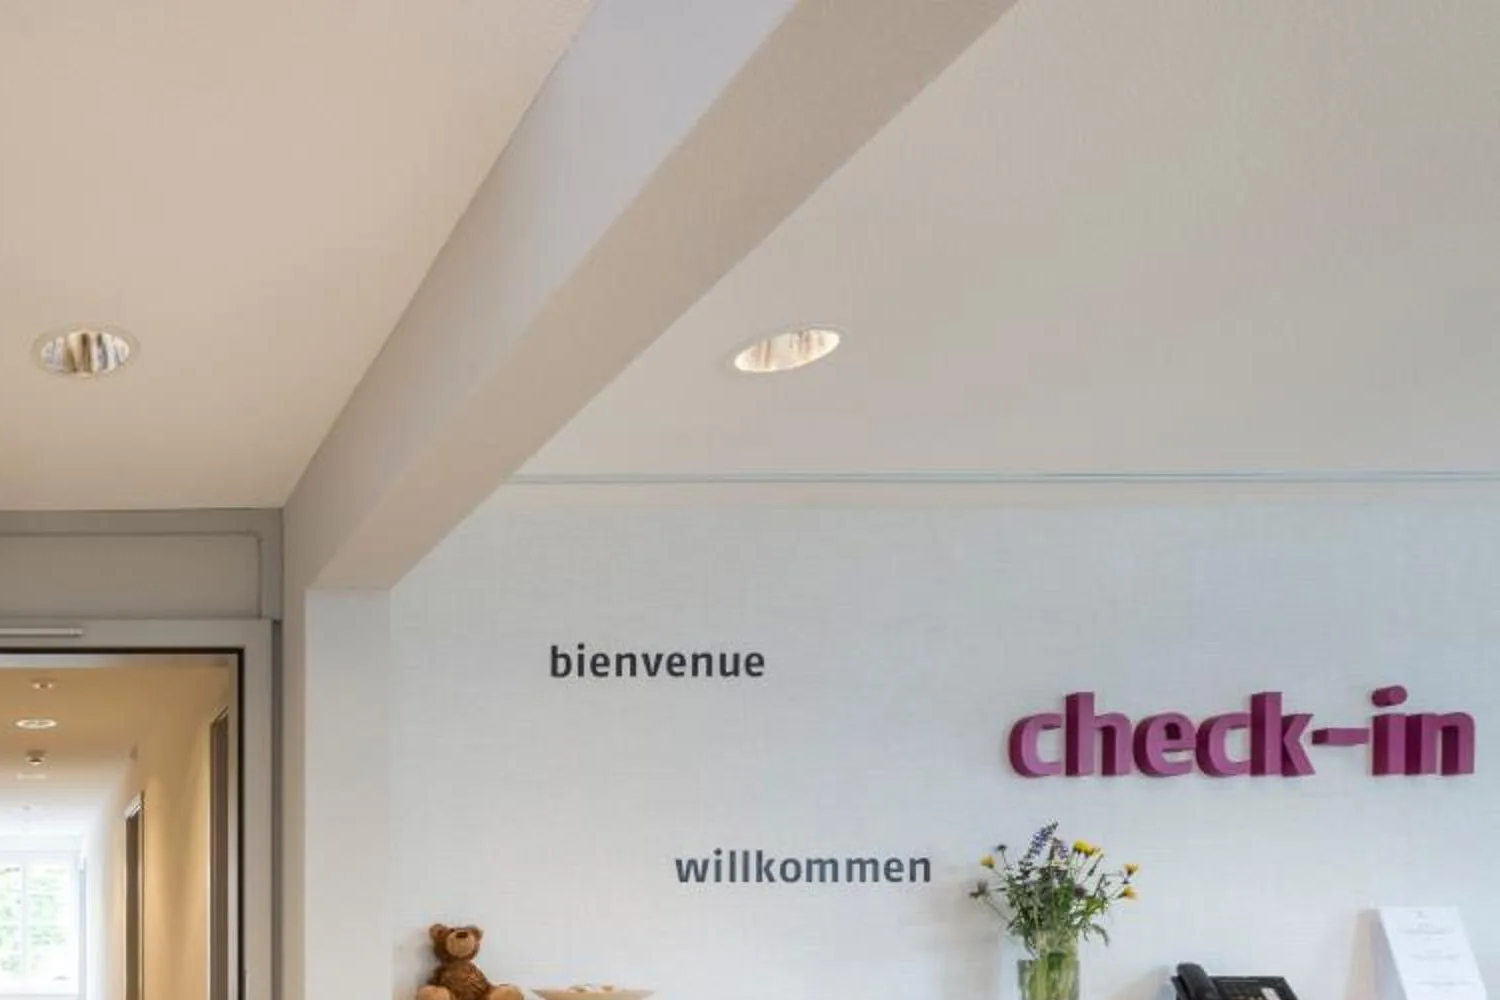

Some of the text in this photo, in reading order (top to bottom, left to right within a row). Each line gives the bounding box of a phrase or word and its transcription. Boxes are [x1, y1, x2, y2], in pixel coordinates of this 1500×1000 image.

[550, 643, 765, 678] bienvenue
[1009, 685, 1475, 776] check-in
[675, 849, 931, 883] willkommen
